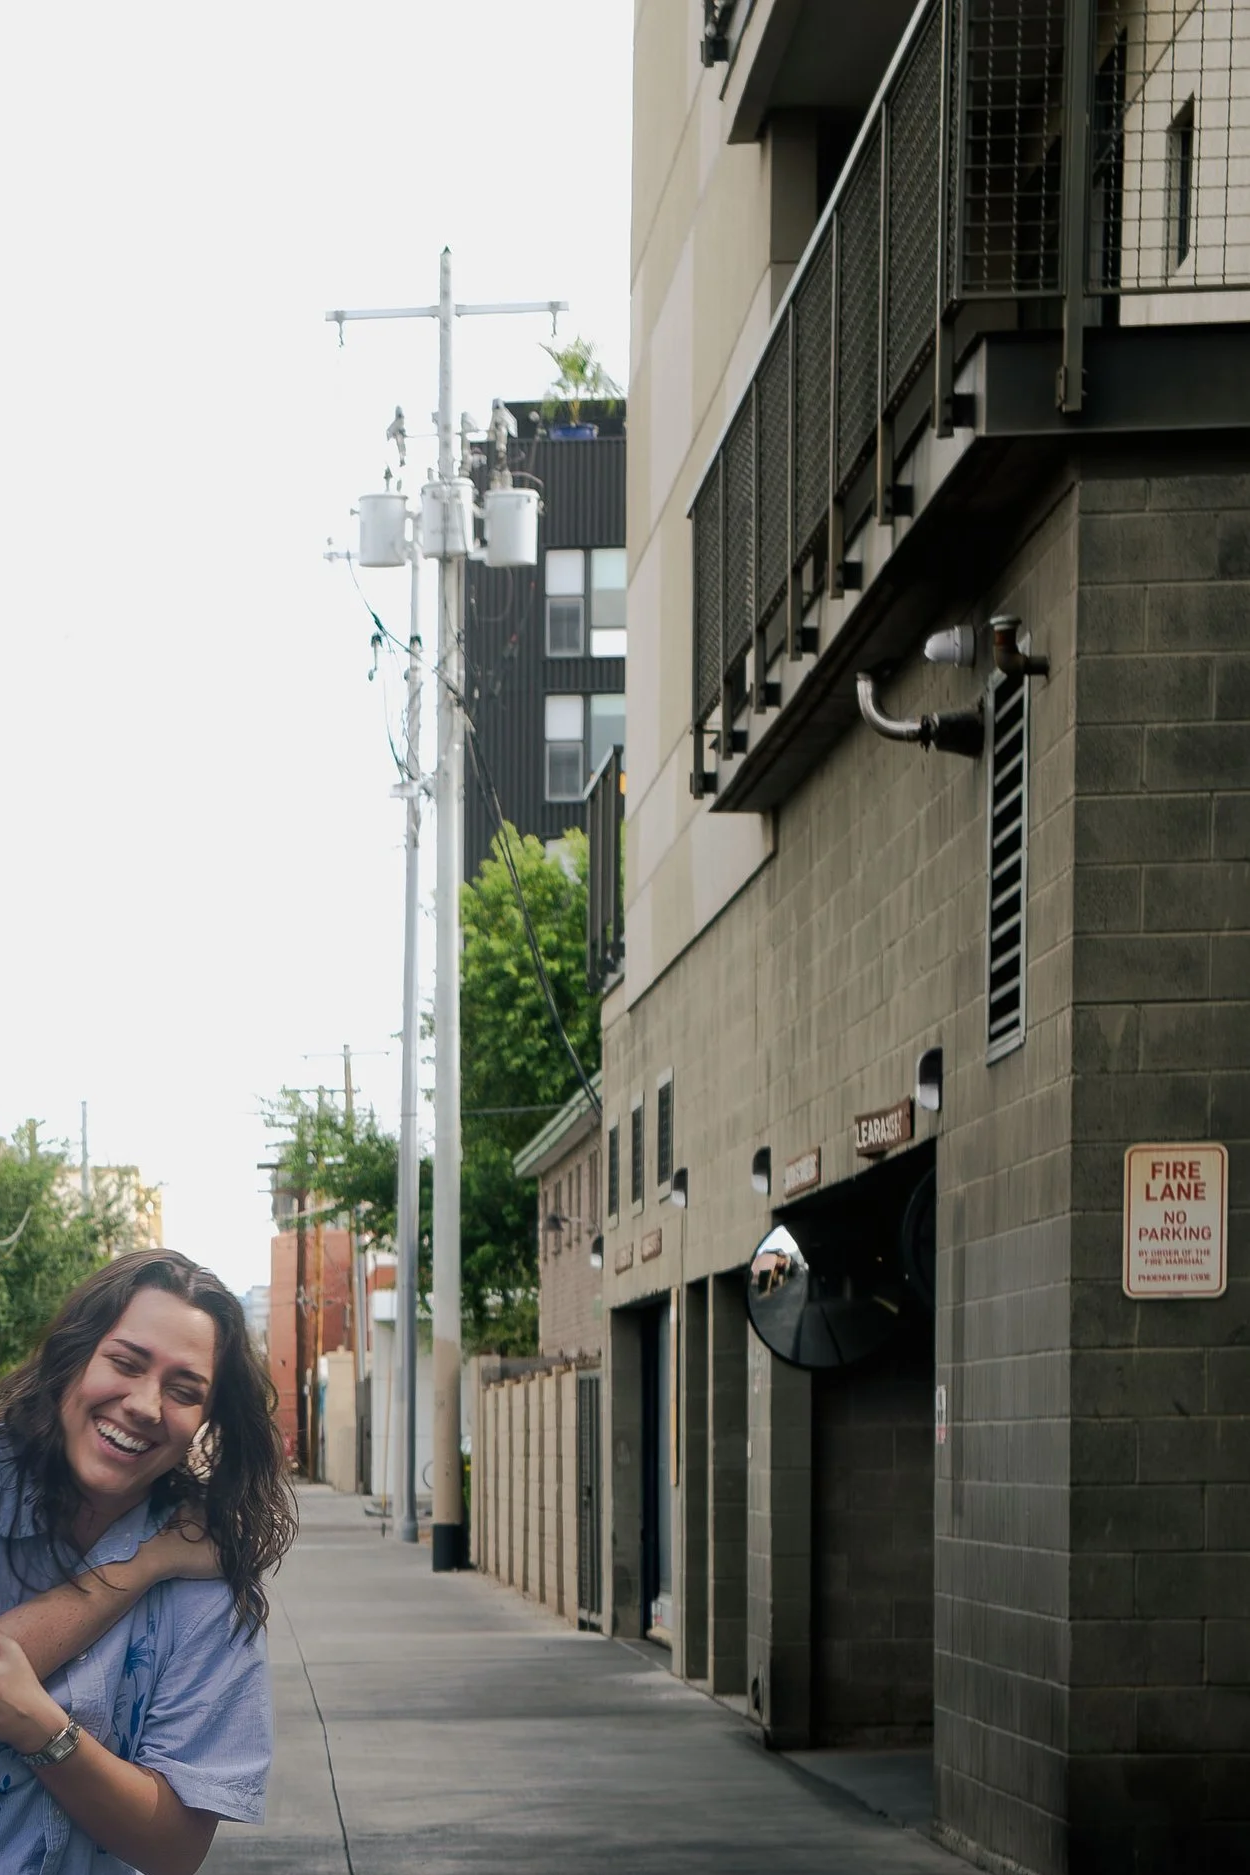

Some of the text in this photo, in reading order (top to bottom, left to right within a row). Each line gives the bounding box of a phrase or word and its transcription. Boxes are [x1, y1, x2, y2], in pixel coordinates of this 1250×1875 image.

[1151, 1160, 1201, 1181] FIRE
[1145, 1181, 1206, 1202] LANE
[1163, 1209, 1187, 1226] NO
[1138, 1225, 1212, 1242] PARKING
[1150, 1248, 1180, 1258] ORDER
[1195, 1247, 1211, 1257] THE
[1144, 1256, 1204, 1267] FIRE MARSHAL
